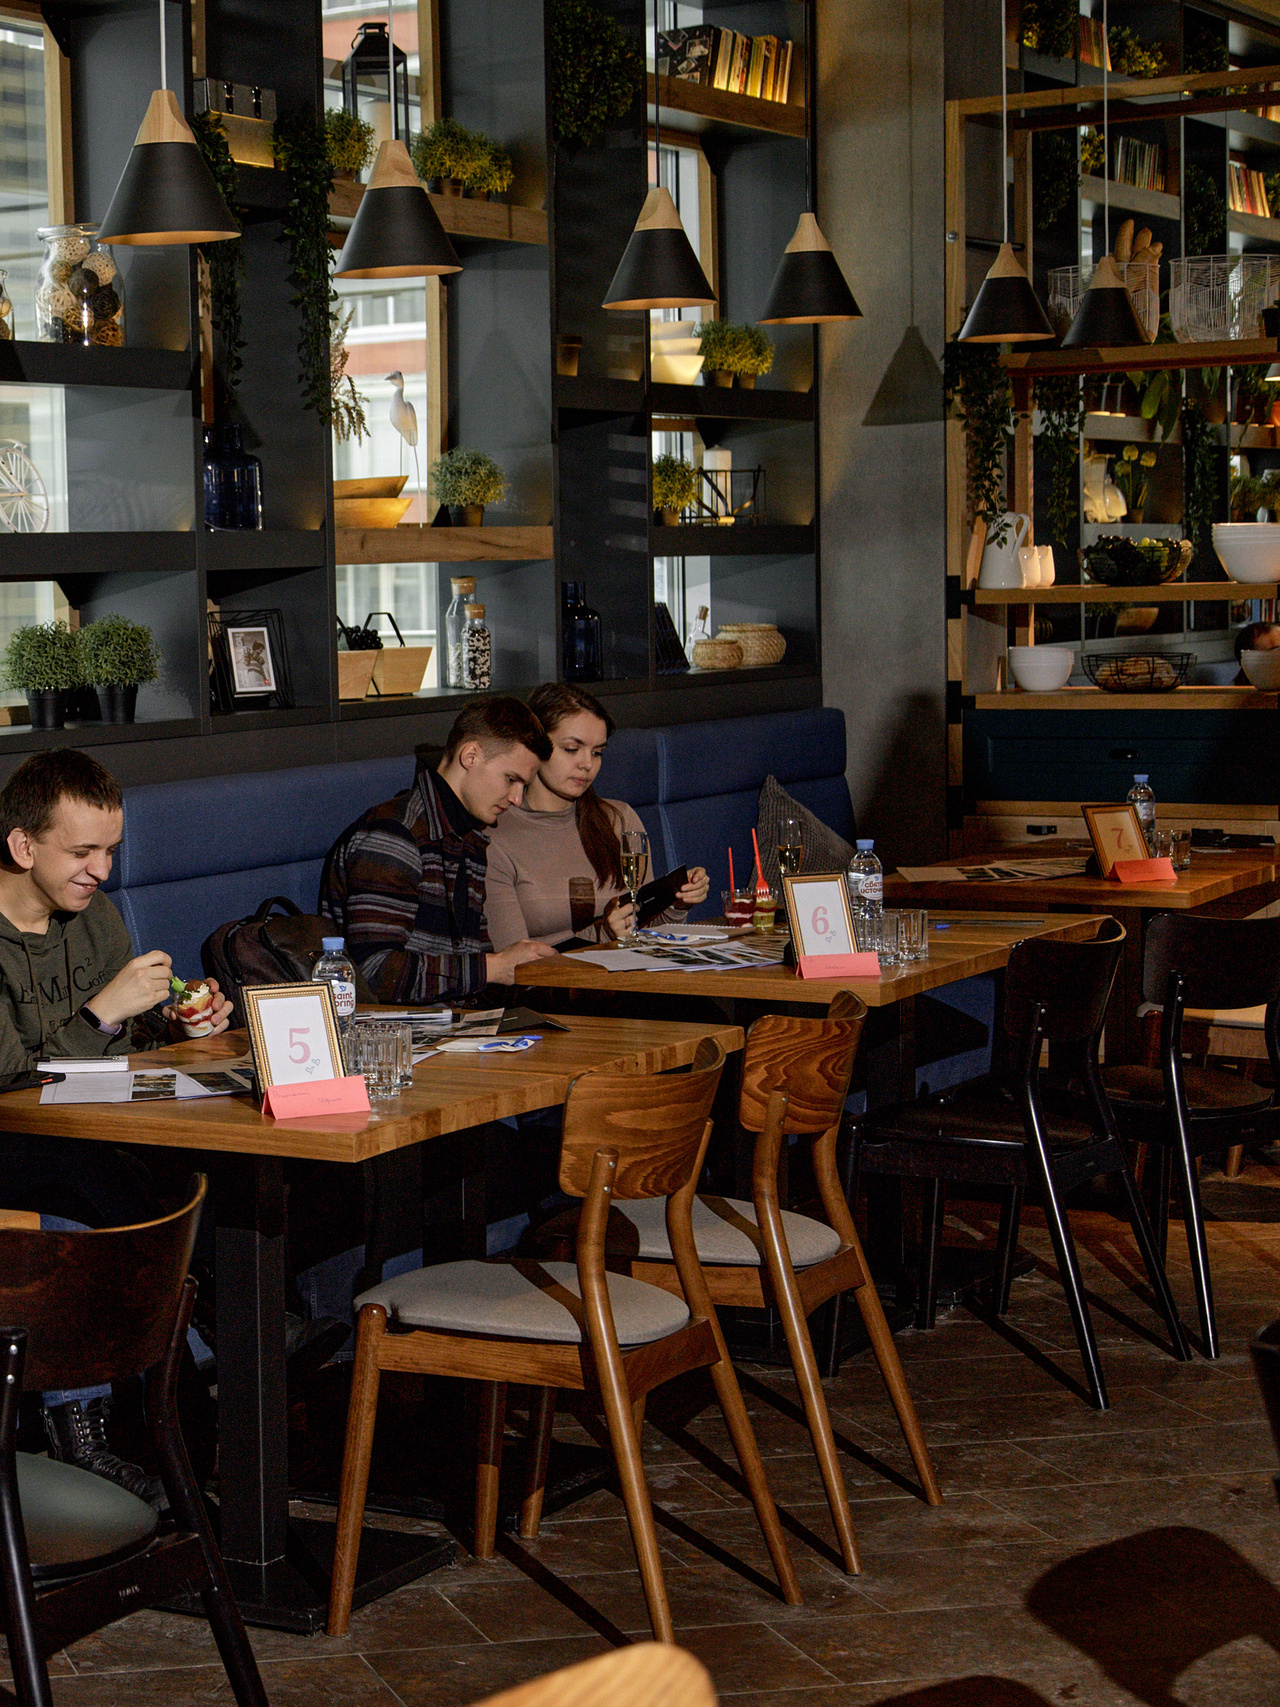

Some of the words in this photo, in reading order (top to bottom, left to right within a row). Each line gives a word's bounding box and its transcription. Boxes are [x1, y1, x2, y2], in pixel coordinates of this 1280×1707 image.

[1111, 827, 1123, 849] 7
[812, 906, 829, 934] 6
[335, 1000, 354, 1008] pring
[288, 1027, 310, 1064] 5
